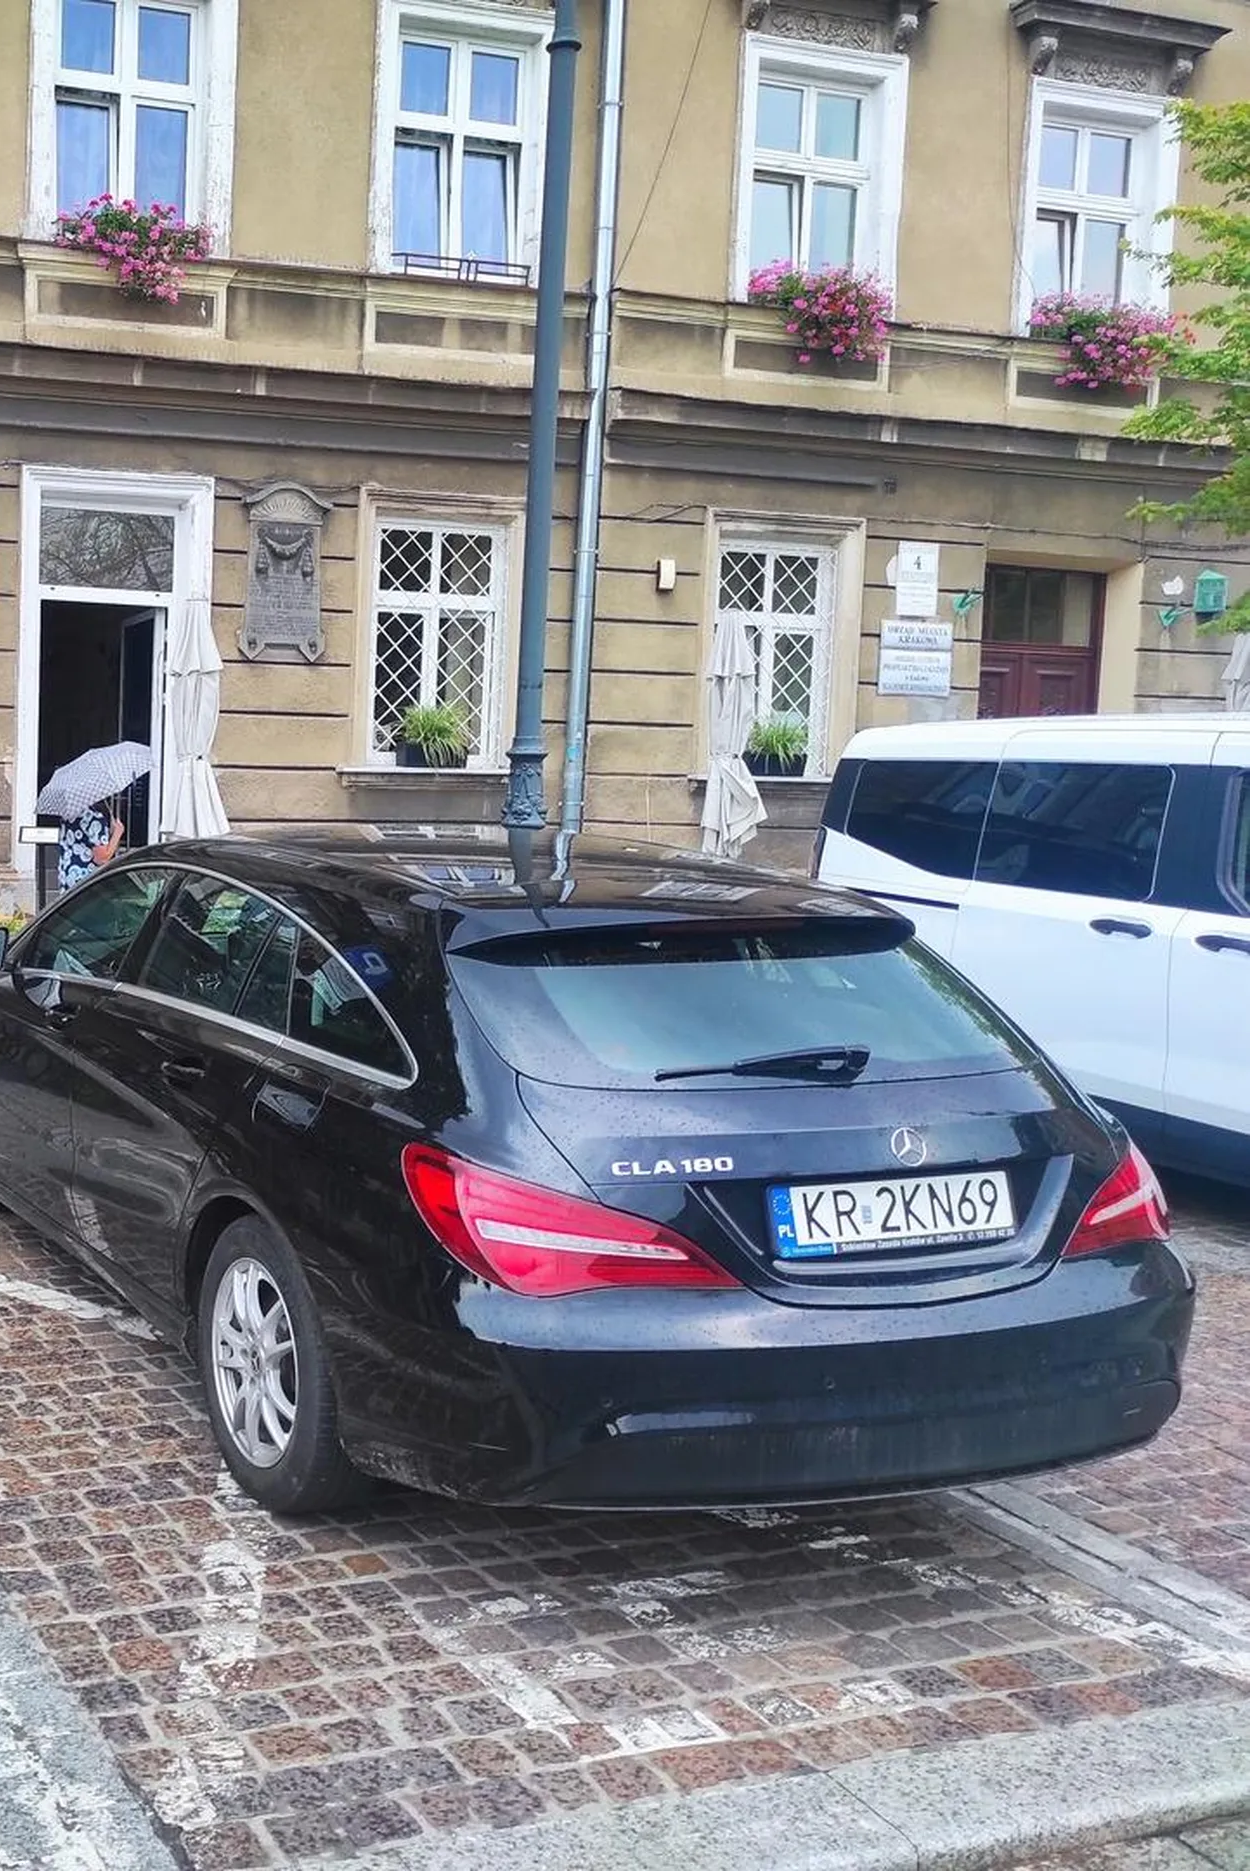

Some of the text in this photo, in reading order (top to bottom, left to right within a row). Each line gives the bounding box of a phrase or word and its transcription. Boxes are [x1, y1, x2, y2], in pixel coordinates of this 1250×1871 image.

[611, 1156, 734, 1176] CLA 180
[802, 1178, 998, 1239] KR 2KN69
[778, 1224, 795, 1239] PL
